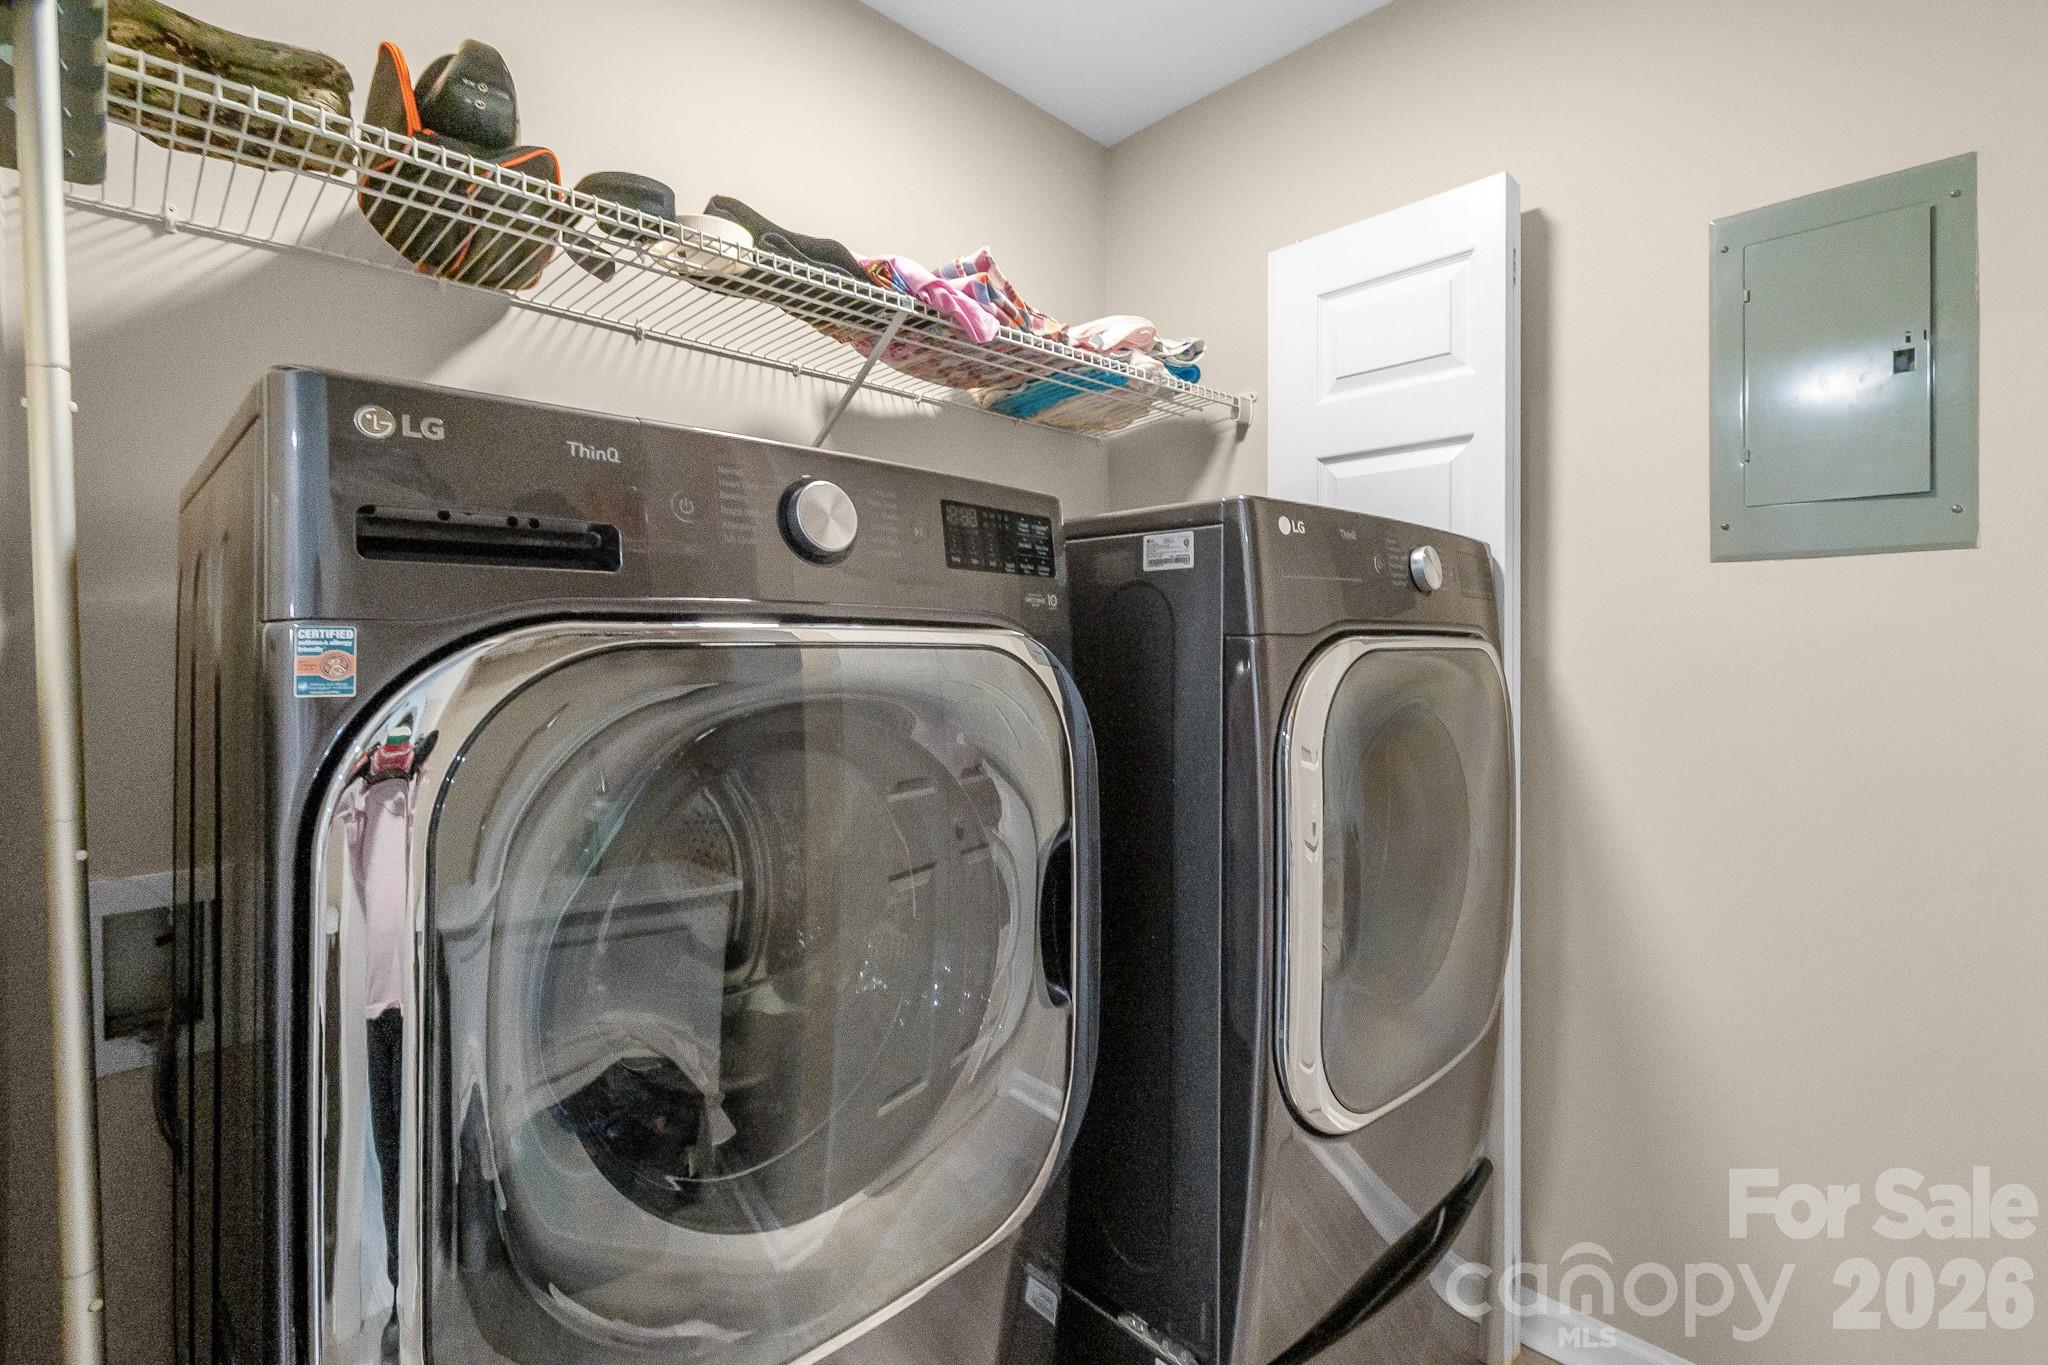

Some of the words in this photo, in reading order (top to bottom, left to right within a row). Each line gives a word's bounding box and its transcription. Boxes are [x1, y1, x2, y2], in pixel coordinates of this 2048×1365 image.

[402, 414, 446, 441] LG
[566, 440, 621, 464] ThinQ
[1292, 519, 1306, 534] LG
[297, 629, 354, 639] CERTIFIED
